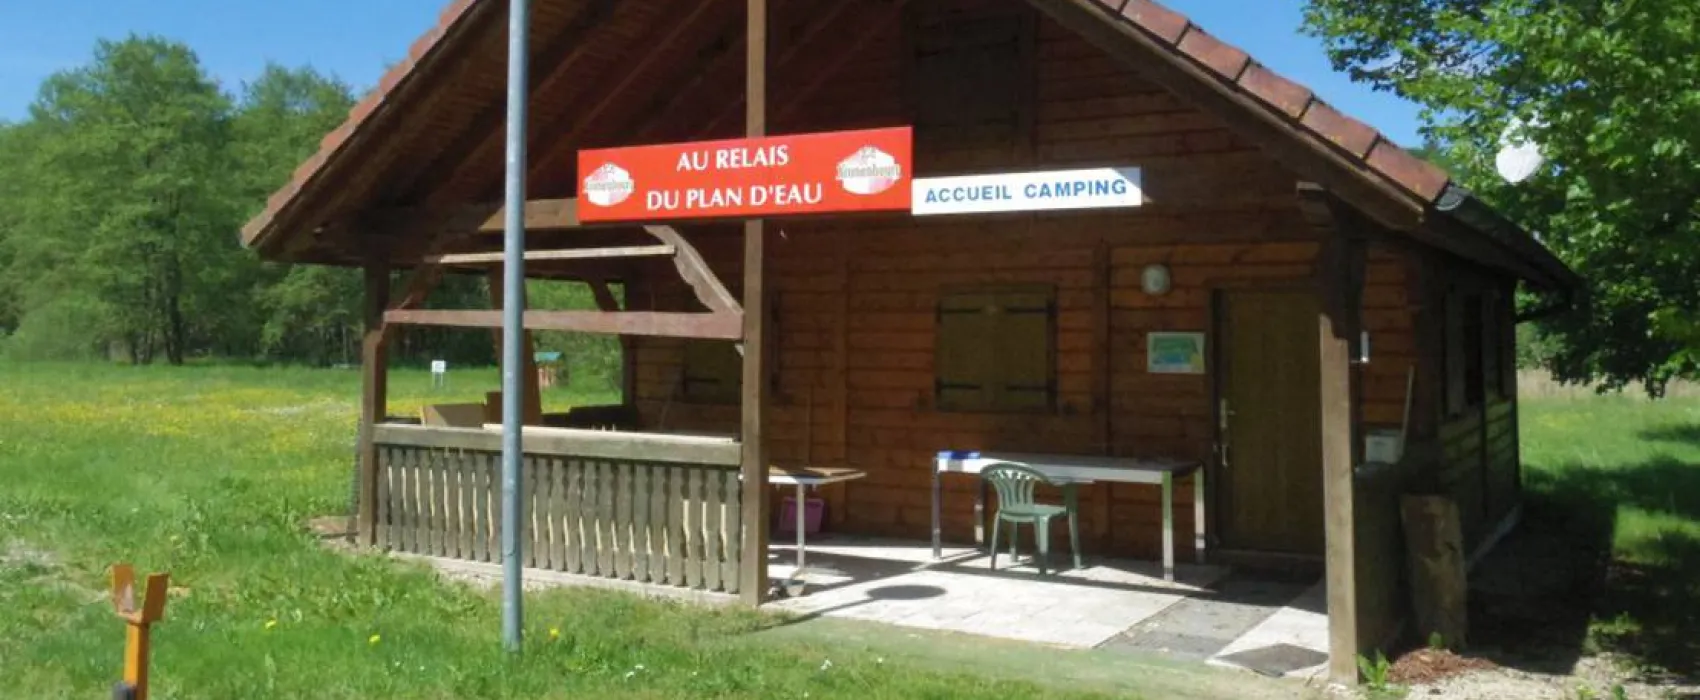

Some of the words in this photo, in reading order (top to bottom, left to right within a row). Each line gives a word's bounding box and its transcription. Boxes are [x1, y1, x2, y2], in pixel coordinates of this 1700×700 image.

[677, 152, 708, 171] AU
[716, 145, 789, 168] RELAIS
[647, 190, 679, 211] DU
[686, 187, 742, 208] PLAN
[751, 183, 822, 205] D'EAU
[925, 185, 1012, 203] ACCUEIL
[1024, 179, 1127, 198] CAMPING
